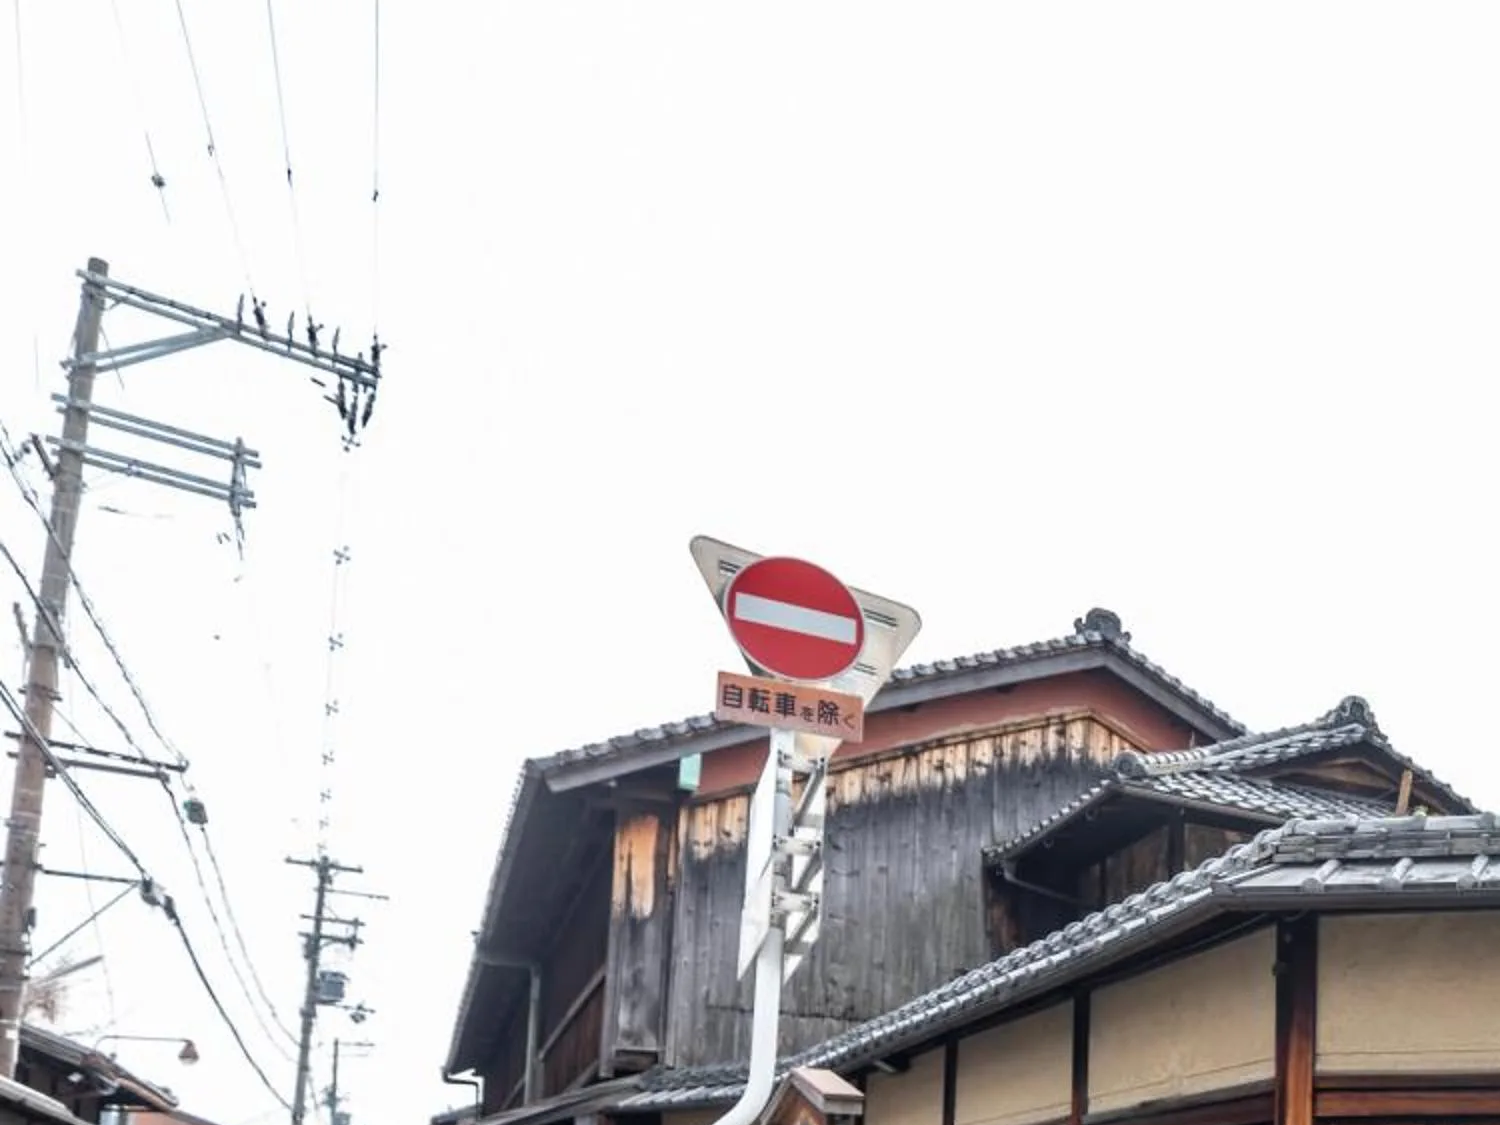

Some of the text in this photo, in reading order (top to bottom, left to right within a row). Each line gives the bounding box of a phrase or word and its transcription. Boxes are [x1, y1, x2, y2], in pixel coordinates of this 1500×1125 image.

[723, 684, 857, 729] 自転車を除く
